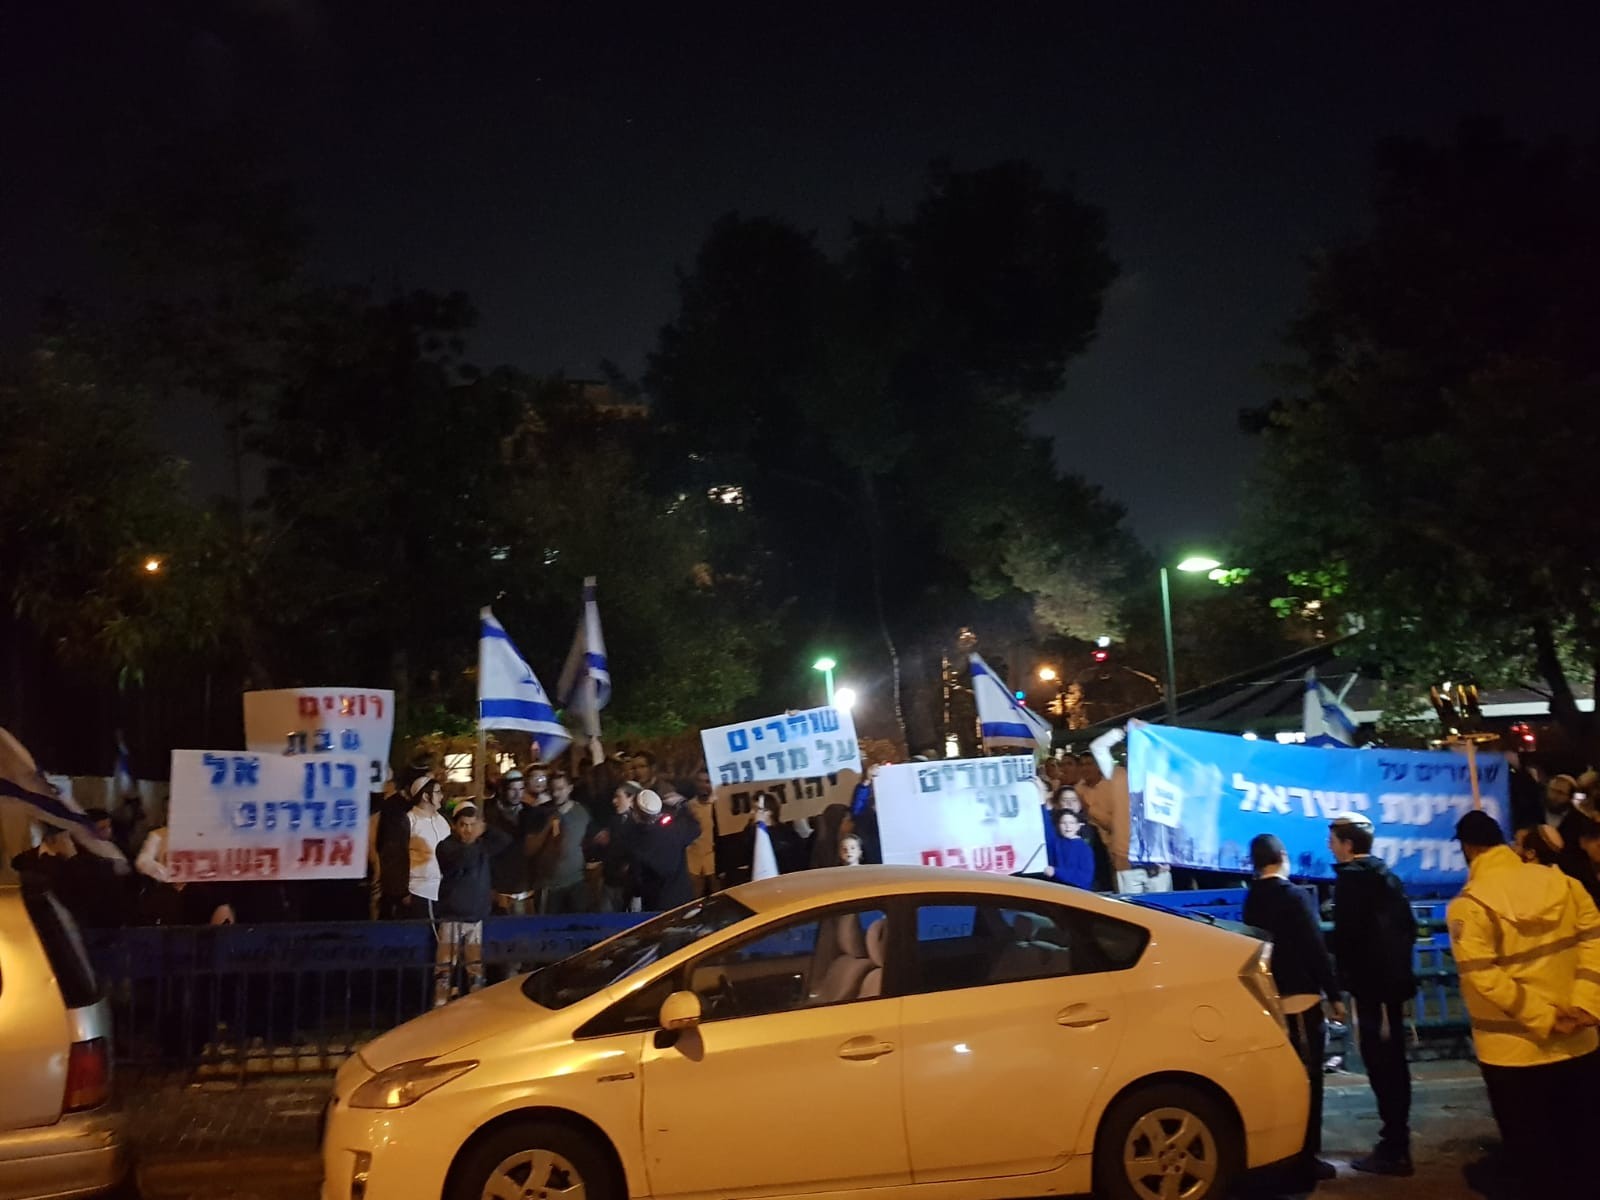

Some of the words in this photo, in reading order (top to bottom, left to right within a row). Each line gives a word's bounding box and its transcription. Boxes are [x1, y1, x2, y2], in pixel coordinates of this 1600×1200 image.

[298, 694, 385, 719] רוצים
[283, 729, 361, 756] שבת
[814, 738, 857, 766] על
[202, 752, 260, 786] אל
[304, 761, 357, 800] רון
[717, 747, 809, 787] מדינה
[918, 757, 1034, 793] שומרים
[1377, 758, 1409, 782] על
[731, 772, 838, 816] יהודת
[975, 791, 1019, 824] על
[1232, 772, 1370, 819] ישראל
[170, 847, 280, 879] השבת
[297, 835, 354, 866] את
